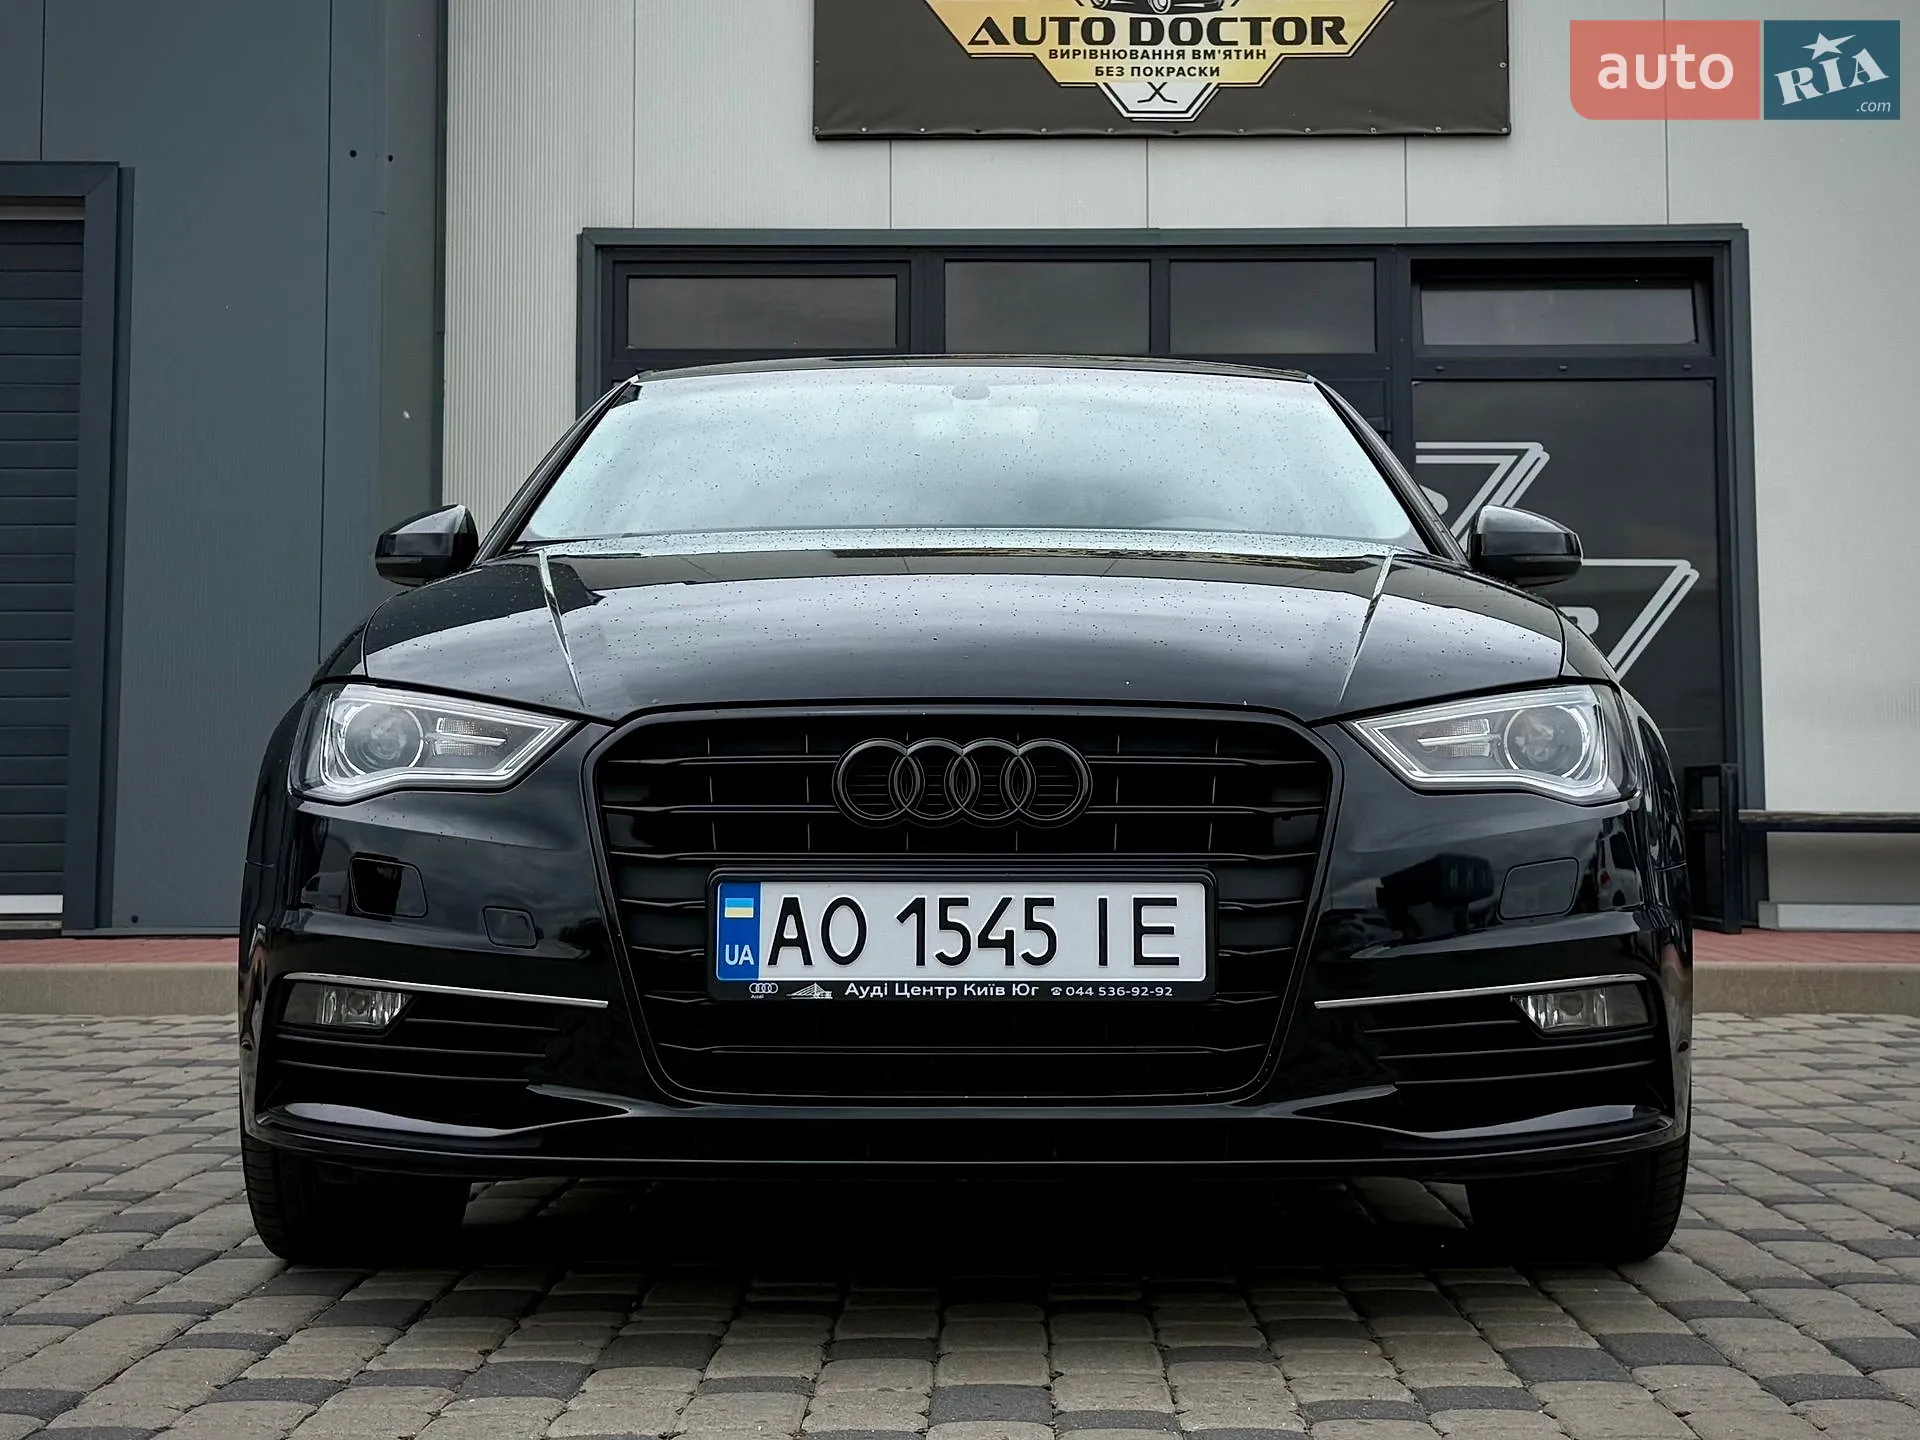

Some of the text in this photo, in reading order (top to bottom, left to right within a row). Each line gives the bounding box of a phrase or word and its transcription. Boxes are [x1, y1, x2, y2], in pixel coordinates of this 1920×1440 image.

[967, 16, 1348, 47] AUTO DOCTOR
[1048, 48, 1267, 60] ВИРІВНЮВАННЯ ВМ'ЯТИН
[1095, 65, 1220, 77] БЕЗ ПОКРАСКИ
[767, 896, 1180, 967] AO 1545 IE
[725, 944, 755, 966] UA
[844, 982, 1040, 1000] Ауді Центр Київ Юг
[1065, 986, 1173, 997] 044 536-92-92
